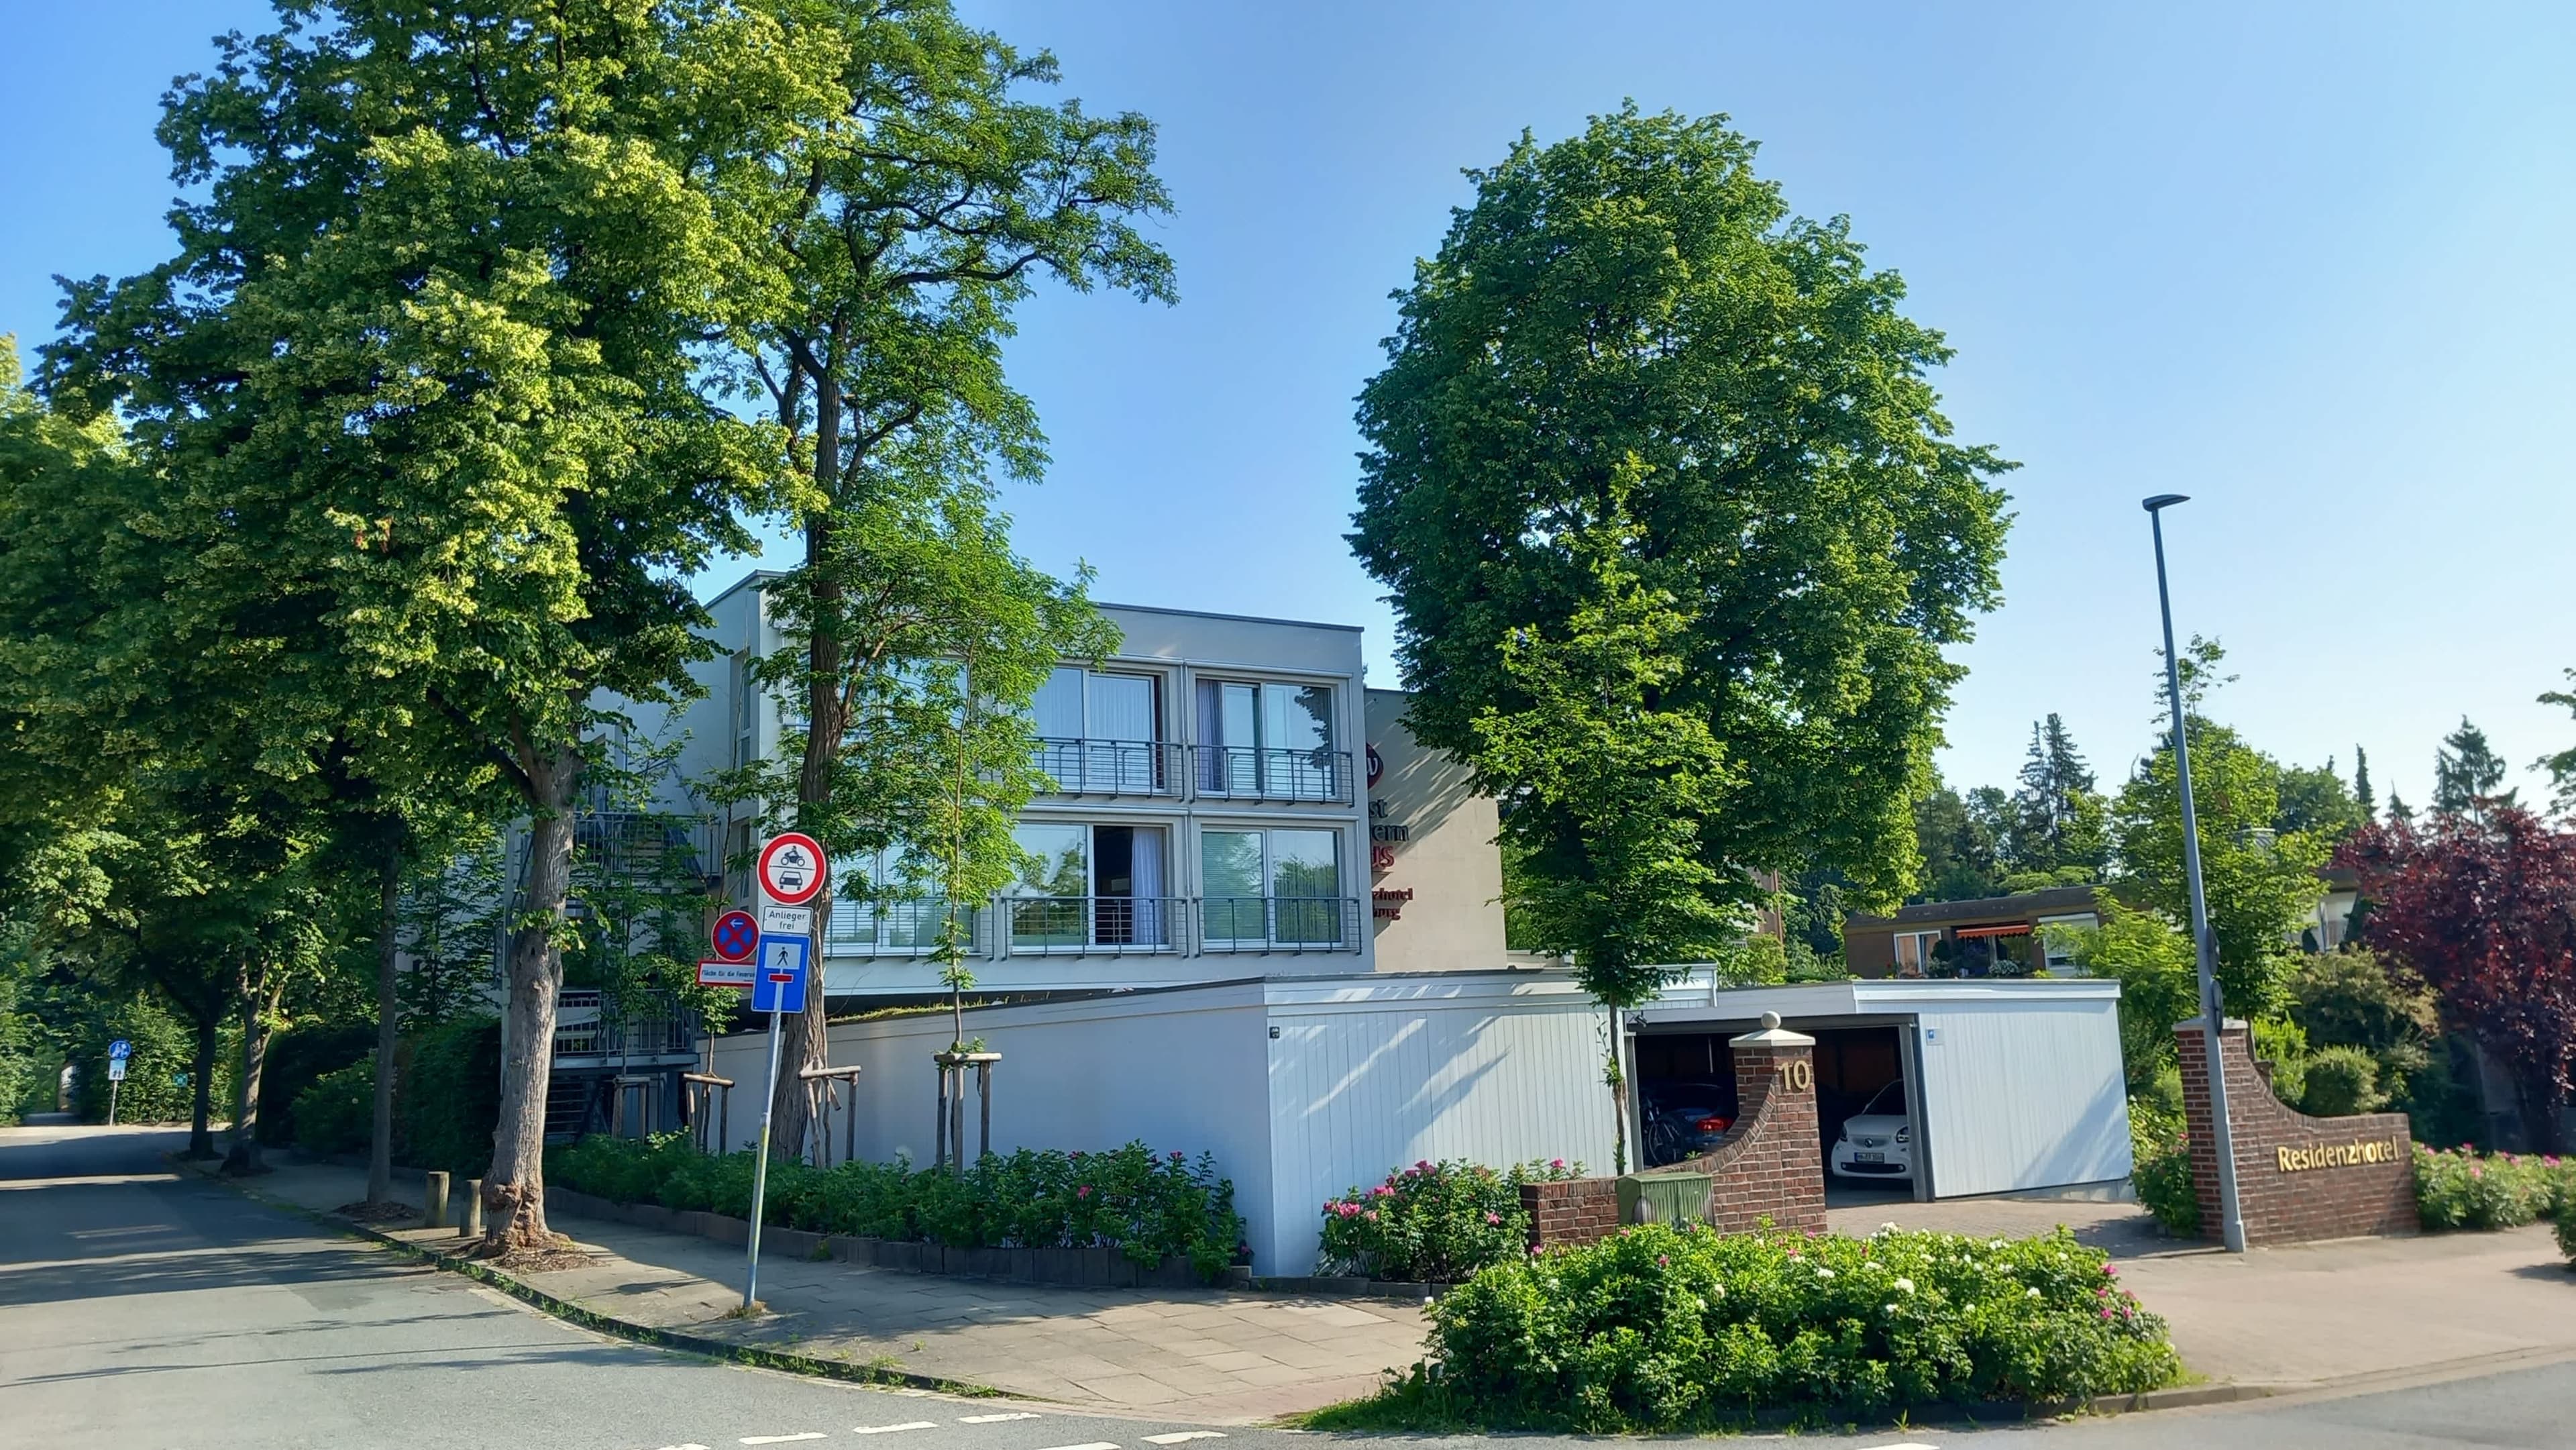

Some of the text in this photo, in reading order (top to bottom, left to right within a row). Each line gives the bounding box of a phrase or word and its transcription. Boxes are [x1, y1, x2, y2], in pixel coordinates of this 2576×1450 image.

[1368, 798, 1388, 818] st
[1372, 825, 1409, 841] ern
[1373, 888, 1413, 900] zhotel
[769, 911, 806, 922] Anlieger
[780, 921, 795, 930] frei
[1781, 1060, 1811, 1090] 10
[2277, 1136, 2399, 1172] Residenzhotel
